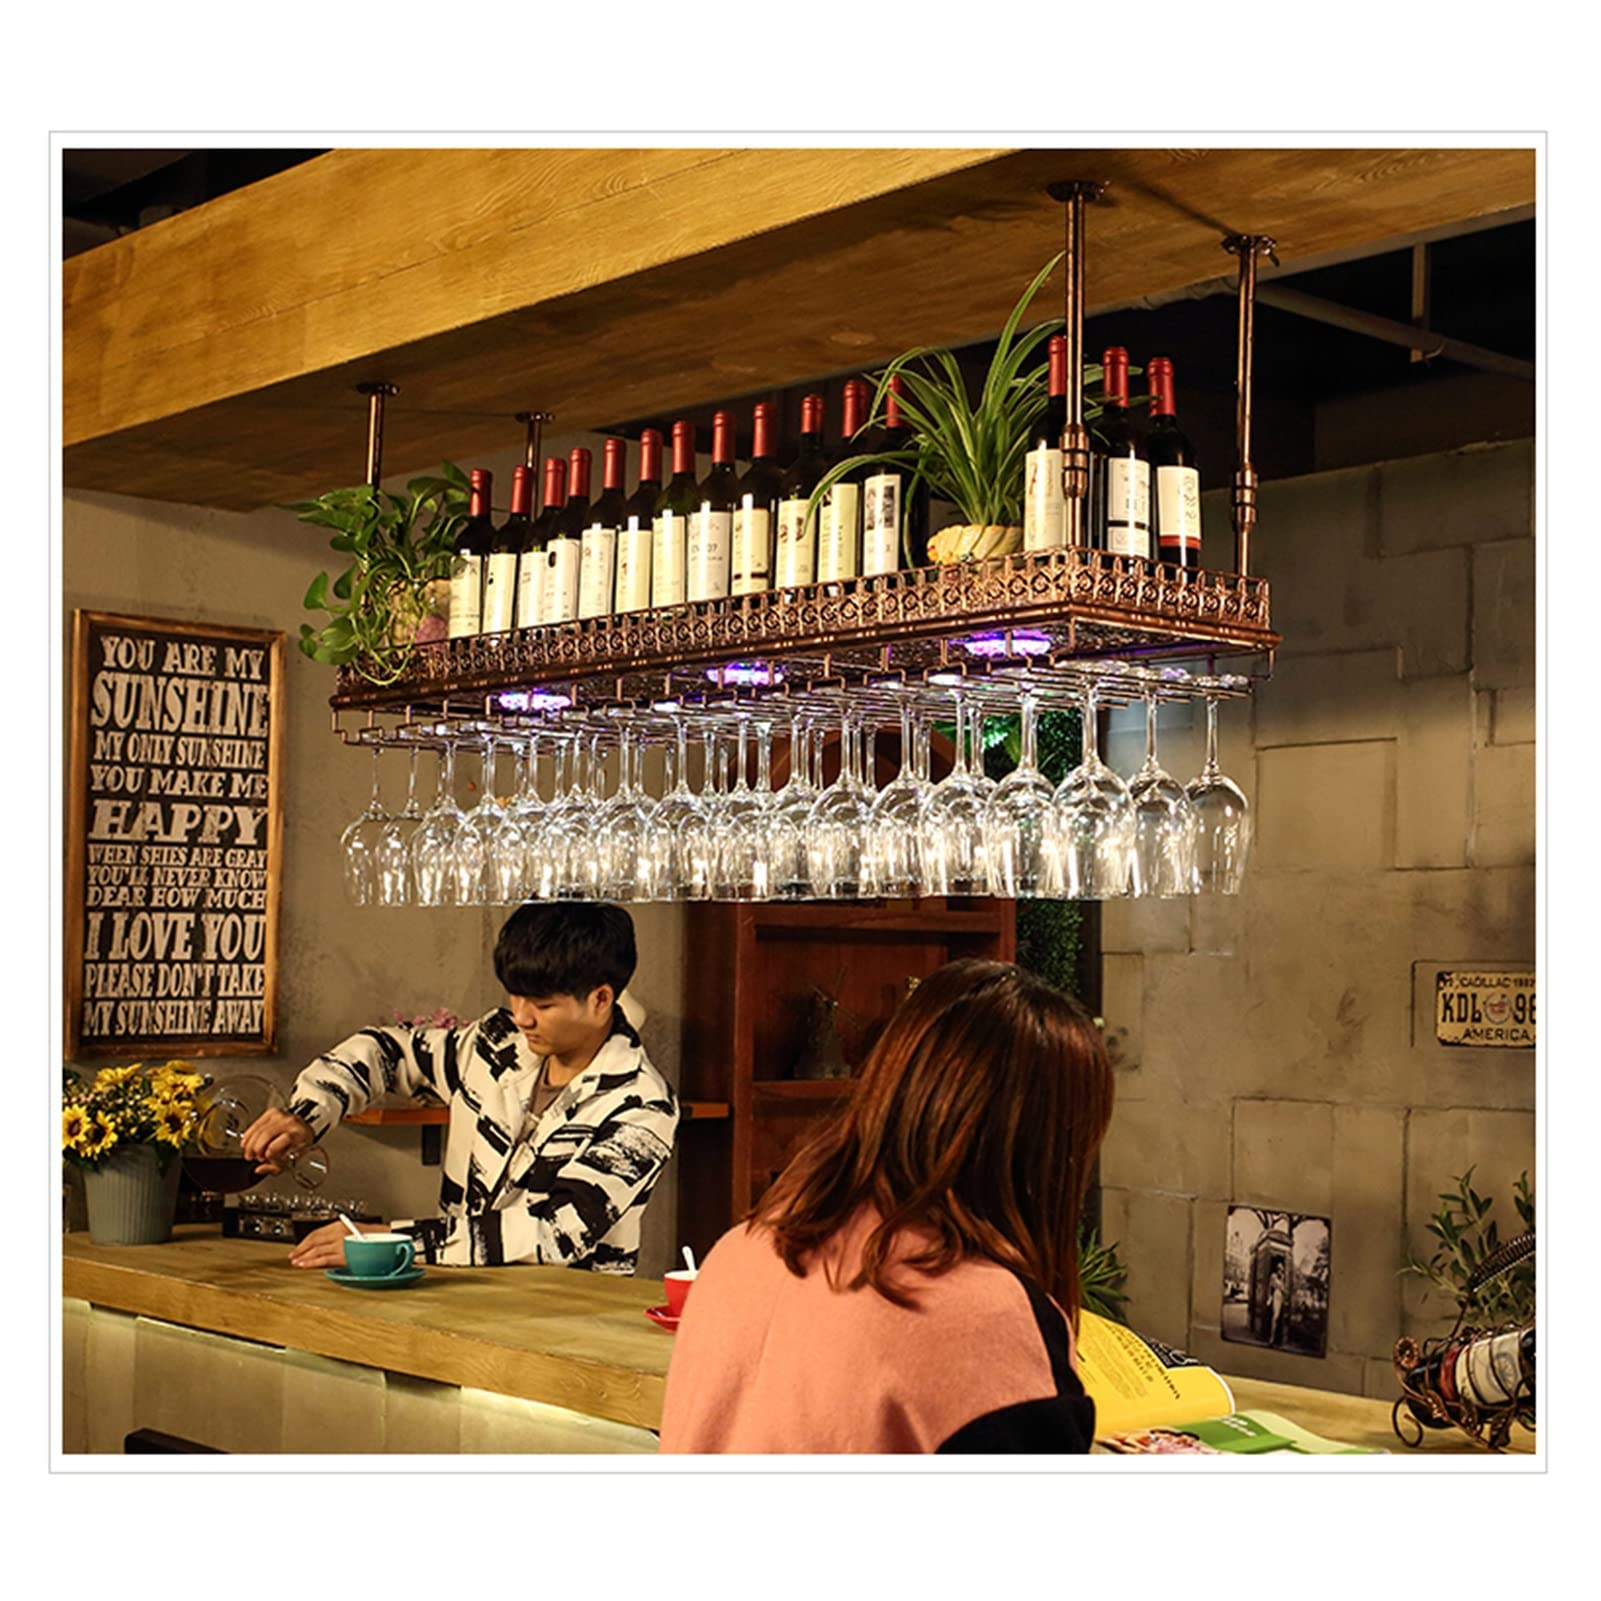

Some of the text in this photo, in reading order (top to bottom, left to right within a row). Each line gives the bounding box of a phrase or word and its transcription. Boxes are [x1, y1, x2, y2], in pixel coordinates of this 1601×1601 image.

[101, 636, 264, 679] YOU ARE MY
[91, 671, 270, 737] SUNSHINE
[94, 731, 266, 769] MY ONLY SUNSHINE
[91, 764, 269, 798] YOU MAKE ME
[88, 799, 269, 845] HAPPY
[88, 844, 138, 864] WHEN
[189, 848, 223, 867] ARE
[226, 849, 267, 868] GRAY
[152, 867, 211, 887] NEVER
[214, 868, 267, 889] KNOW
[86, 887, 266, 909] DEAR HOW MUCH
[85, 911, 266, 961] I LOVE YOU
[85, 963, 265, 998] PLEASE DON'T TAKE
[82, 1000, 264, 1036] MY SUNSHINE AWAY
[1462, 1028, 1532, 1041] AMERICA
